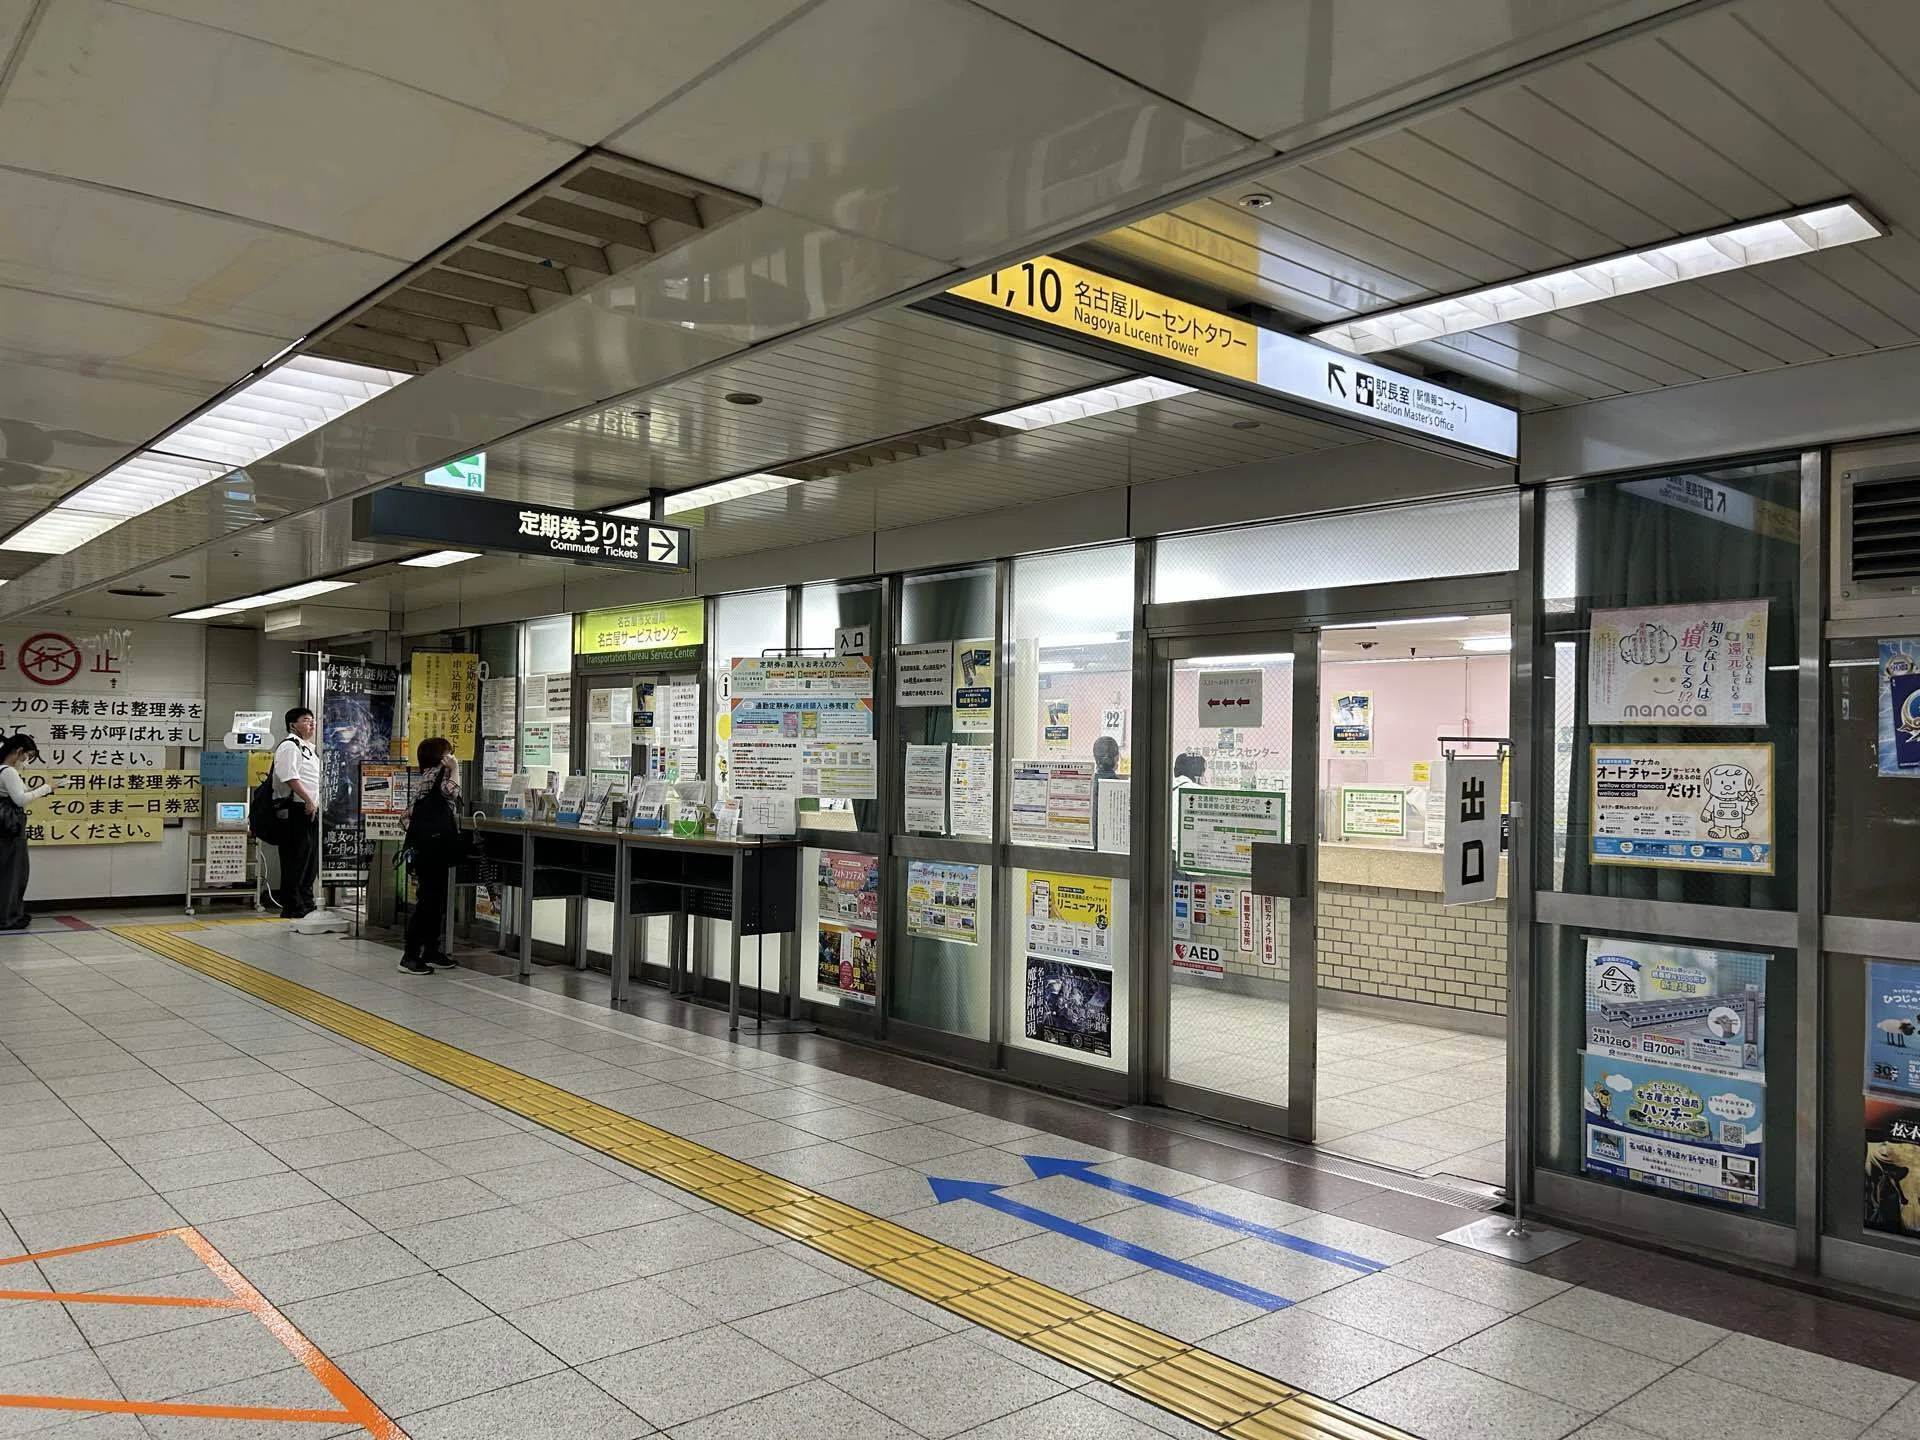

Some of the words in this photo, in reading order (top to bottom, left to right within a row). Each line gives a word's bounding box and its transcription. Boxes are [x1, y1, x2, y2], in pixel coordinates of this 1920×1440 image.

[1074, 281, 1247, 348] 名古屋ルーセントタワー
[1074, 307, 1120, 334] Nagoya
[1124, 323, 1163, 347] Lucent
[1167, 336, 1199, 357] Tower
[1375, 379, 1409, 405] 駅長室
[1375, 399, 1402, 416] Station
[1403, 407, 1433, 425] Master's
[1434, 416, 1454, 431] Office
[518, 511, 639, 548] 定期券うりば
[550, 539, 600, 555] Commuter
[603, 545, 638, 559] Tickets
[597, 627, 688, 648] 名古屋サービスセンター
[840, 632, 864, 649] 入口
[586, 651, 627, 664] Transportation
[627, 650, 649, 661] Bureau
[650, 650, 673, 660] Service
[674, 648, 697, 658] Center
[1697, 621, 1724, 700] 知らない人は
[1624, 705, 1707, 717] manaca
[1106, 712, 1120, 728] 22
[50, 724, 201, 742] 番号が呼ばれまし
[245, 733, 261, 744] 92
[1597, 766, 1672, 780] オートチャージ
[20, 774, 200, 790] のご用件は整理券不
[1667, 783, 1701, 798] だけ!
[49, 798, 200, 815] そのまま一日券窓
[1461, 776, 1485, 885] 出口
[1057, 898, 1108, 915] リニューアル!
[1189, 945, 1219, 961] AED
[1597, 979, 1637, 995] ハシ鉄
[1883, 994, 1920, 1004] ひつじの
[1655, 1044, 1681, 1057] 700円
[1637, 1090, 1699, 1109] 名古屋市交通局
[1642, 1104, 1692, 1120] ハッチー
